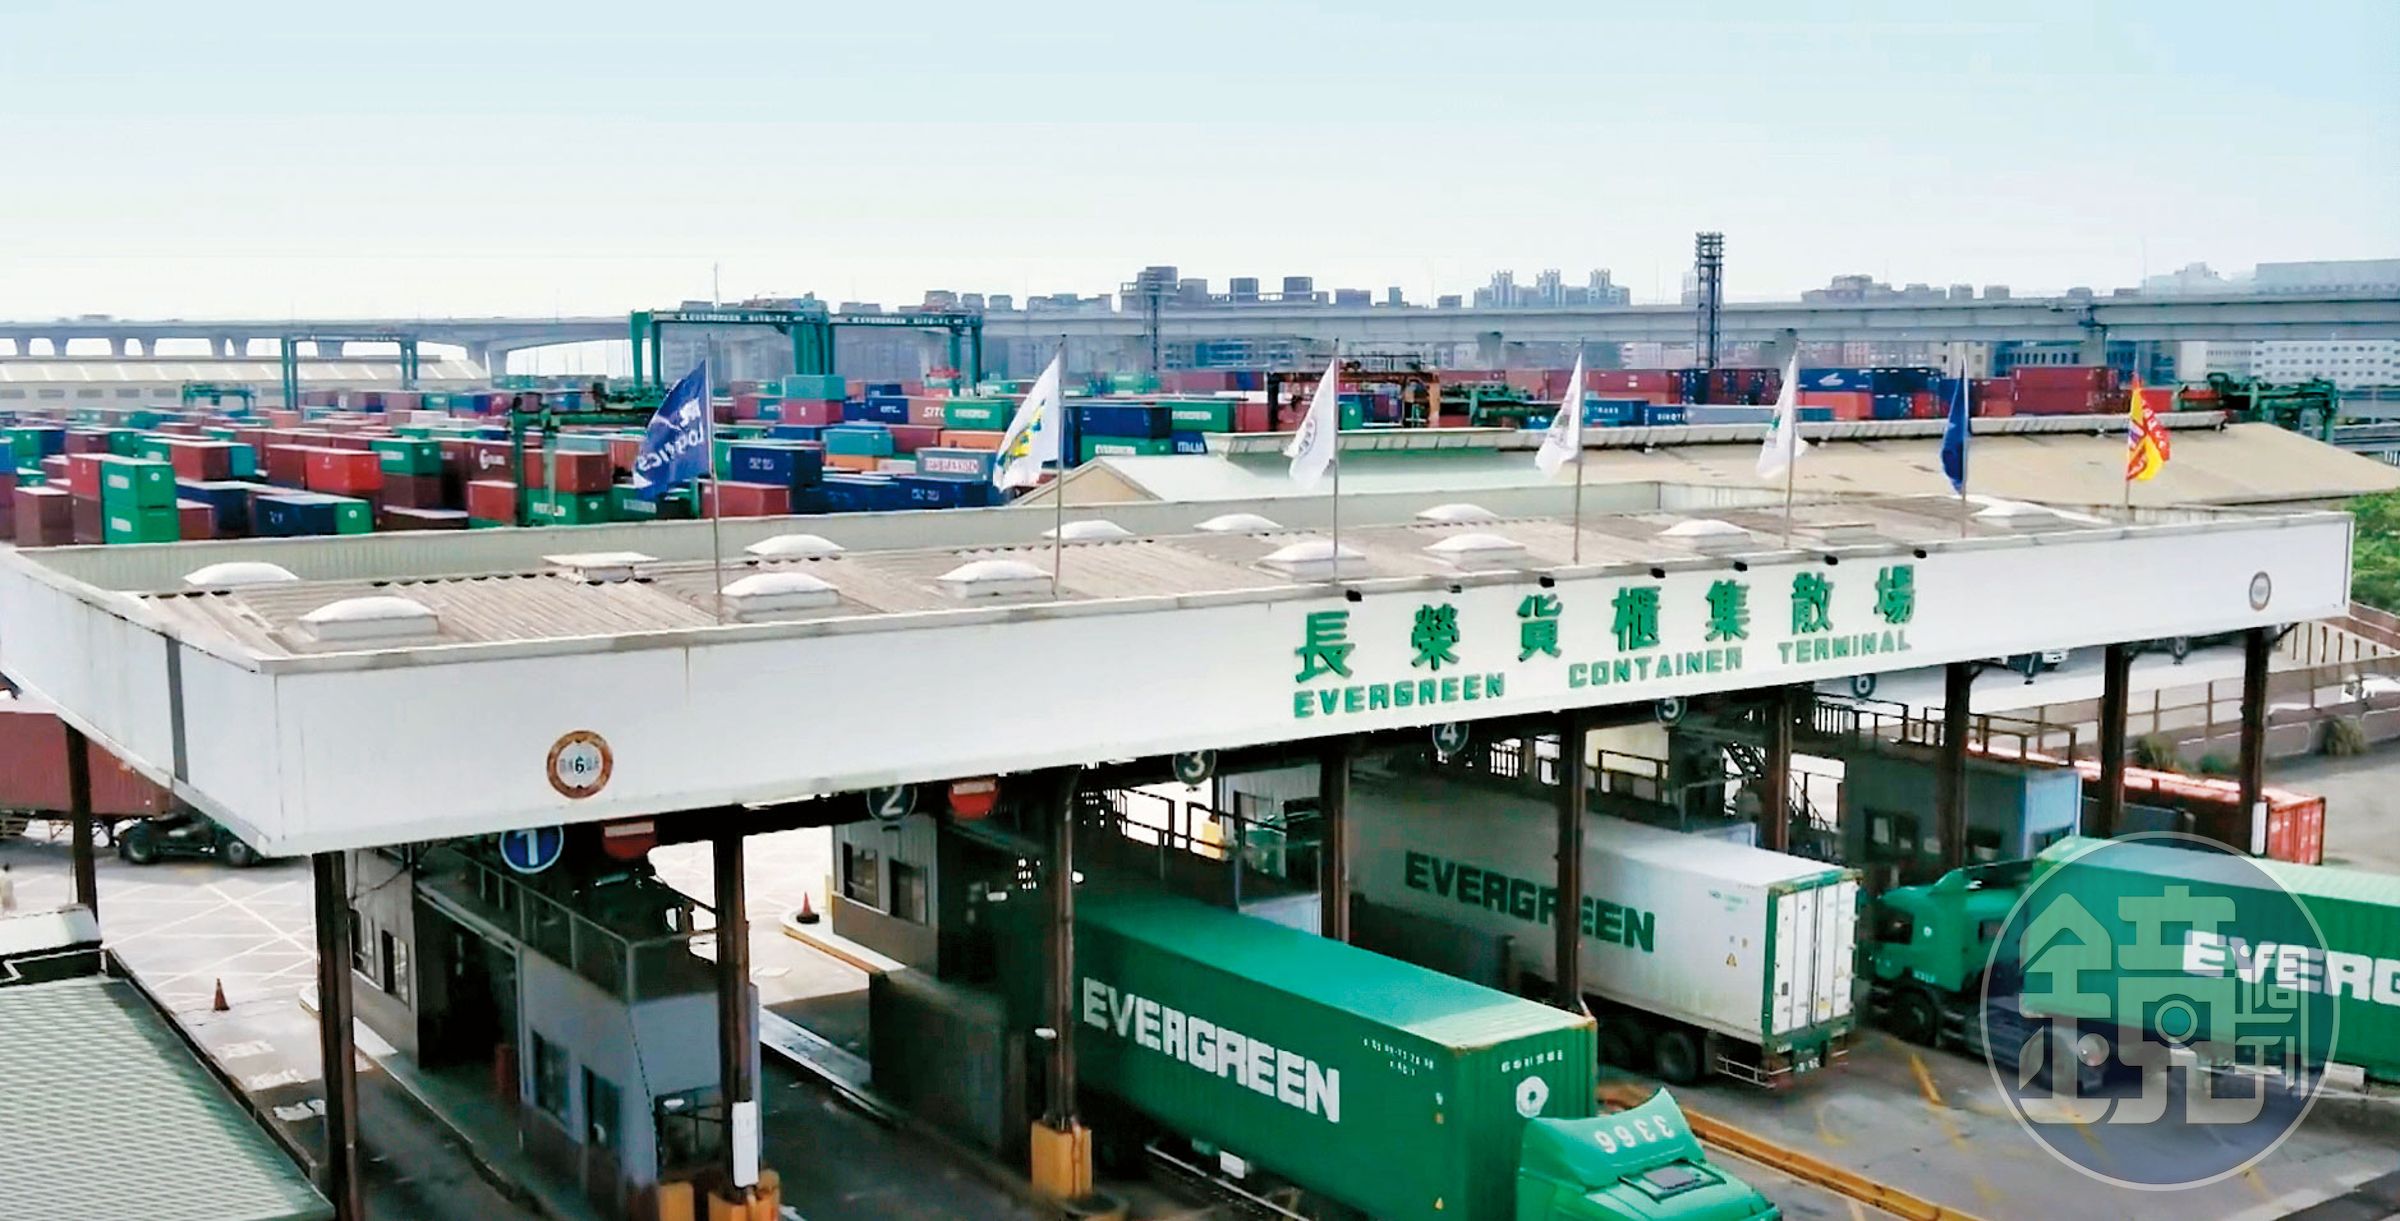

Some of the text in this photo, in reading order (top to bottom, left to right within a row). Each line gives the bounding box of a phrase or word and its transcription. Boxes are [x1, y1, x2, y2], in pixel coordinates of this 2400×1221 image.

[1294, 563, 1917, 685] 長榮貨櫃集散場
[1293, 629, 1912, 718] EVERGREEN CONTAINER TERMINAL
[1440, 722, 1458, 746] 4
[879, 784, 903, 816] 2
[515, 829, 539, 865] 1
[1083, 976, 1341, 1124] EVERGREEN
[1594, 1114, 1675, 1154] 3366
